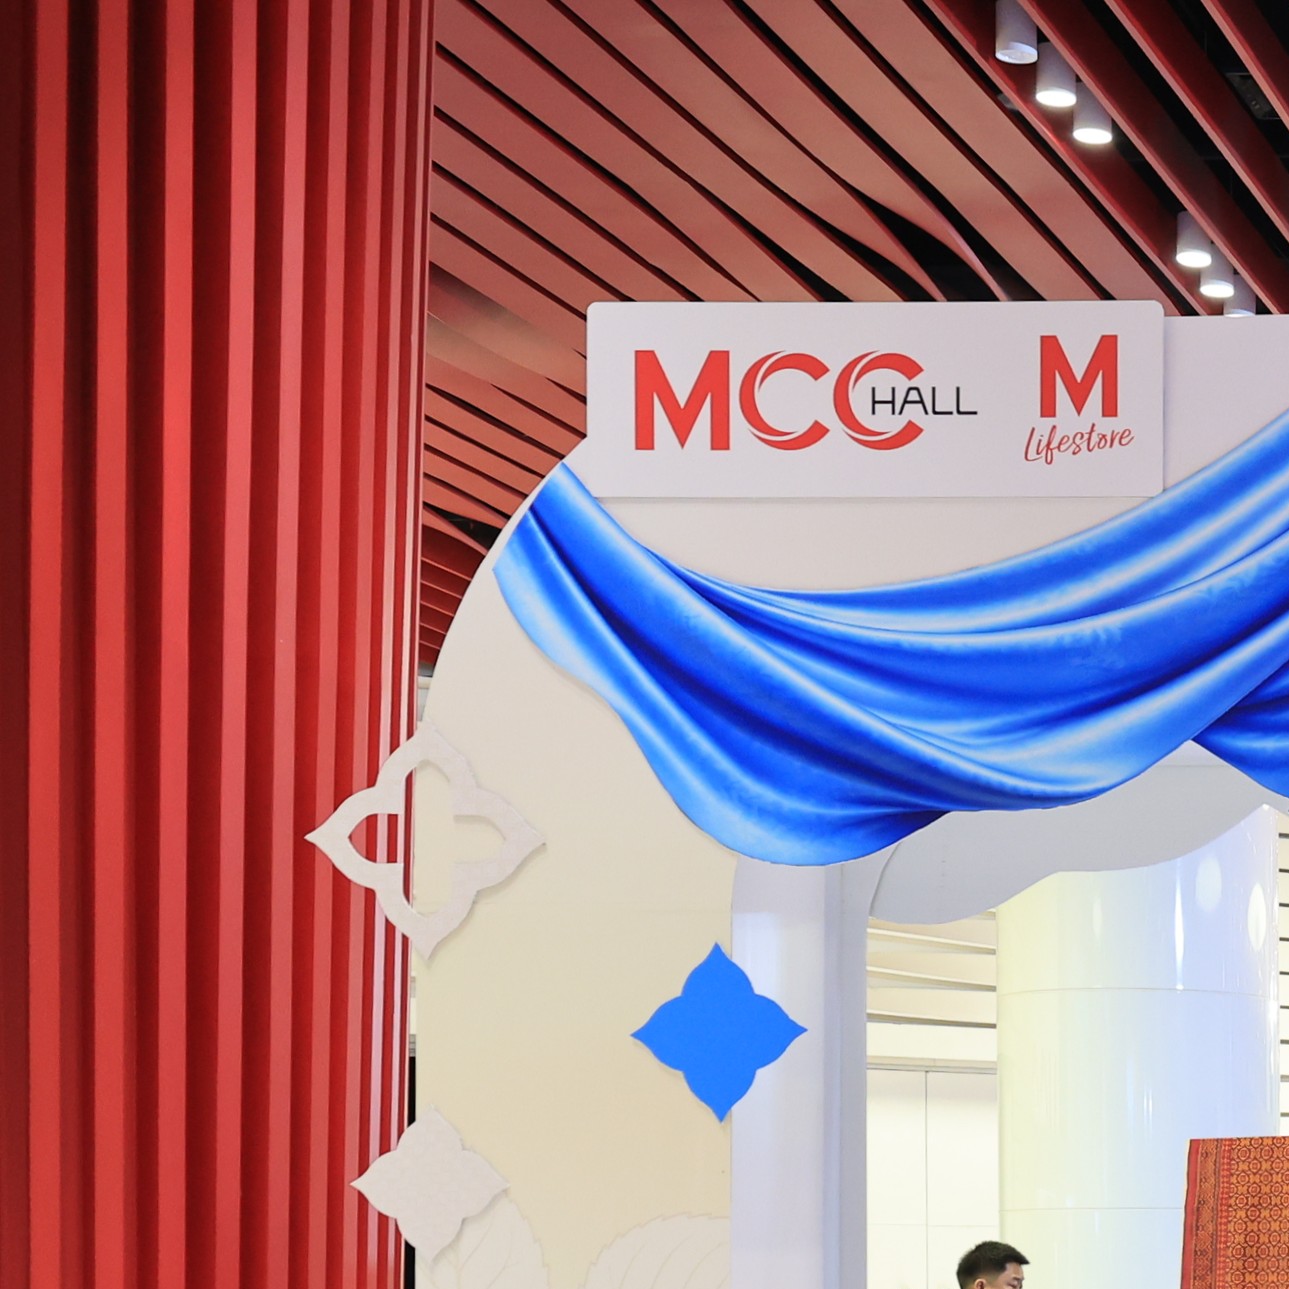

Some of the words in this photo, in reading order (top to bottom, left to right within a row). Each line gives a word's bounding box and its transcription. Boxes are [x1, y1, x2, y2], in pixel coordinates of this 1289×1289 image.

[634, 350, 924, 451] MCC
[870, 386, 977, 416] HALL
[1039, 334, 1118, 418] M
[1024, 423, 1135, 464] Lifestore
